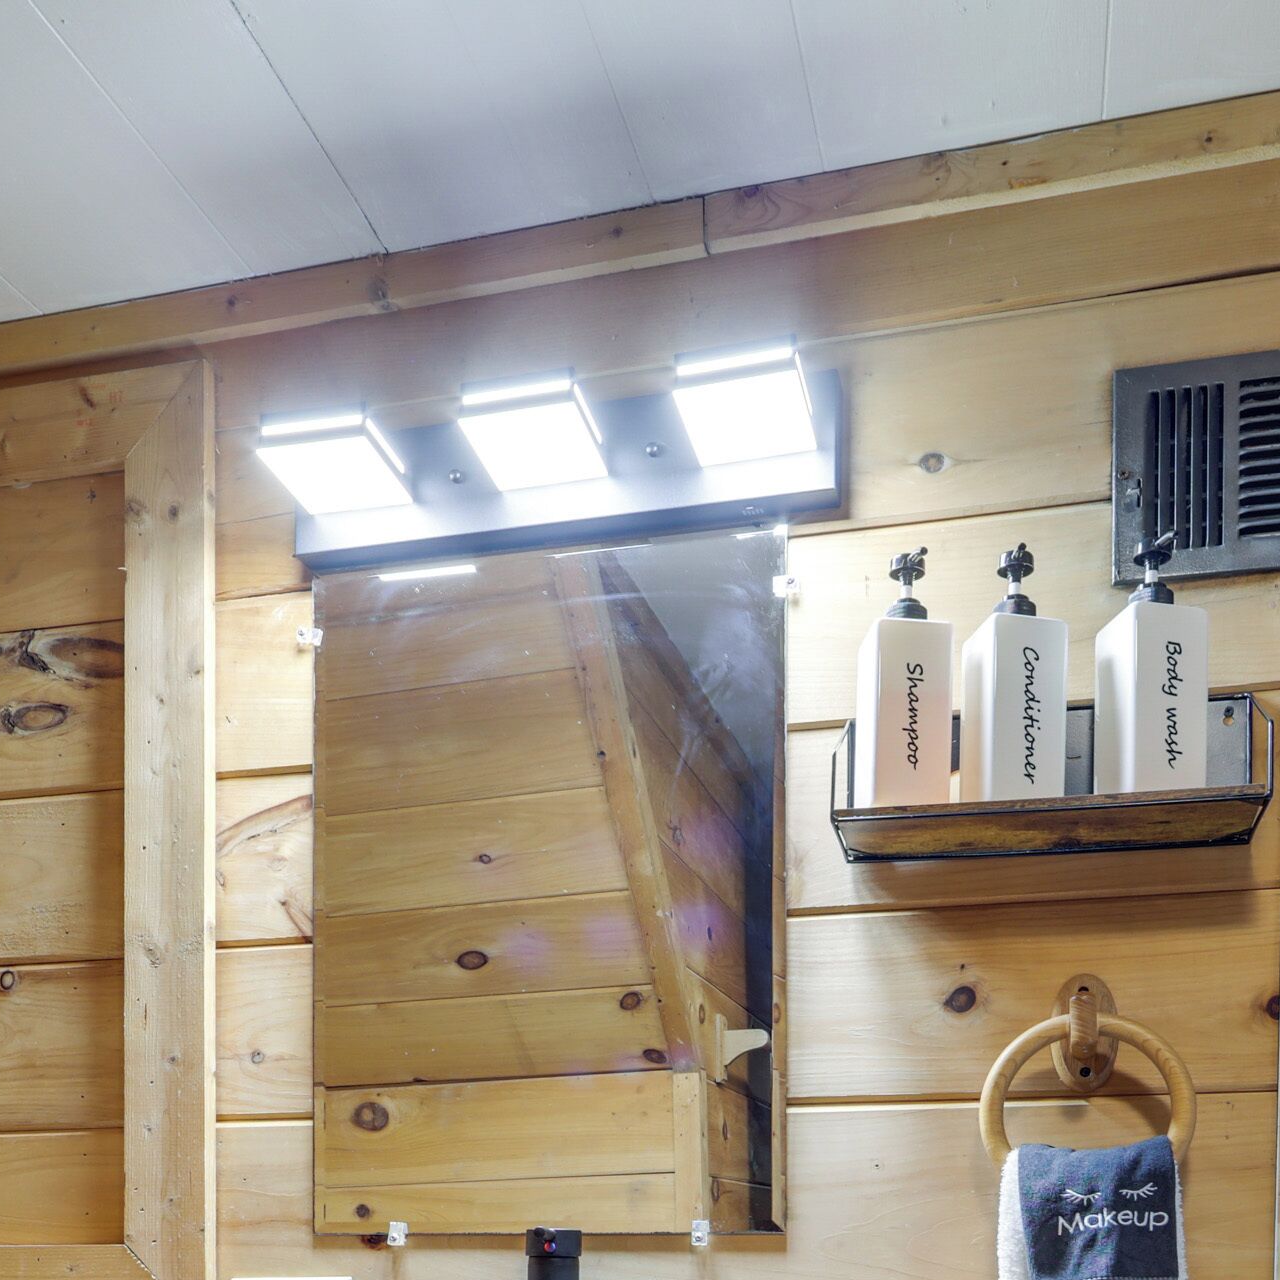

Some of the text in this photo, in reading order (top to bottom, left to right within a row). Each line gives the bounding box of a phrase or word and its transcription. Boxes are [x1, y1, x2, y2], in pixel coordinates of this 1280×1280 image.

[903, 662, 925, 771] Shampoo
[1022, 646, 1041, 785] Conditioner
[1161, 640, 1183, 770] Body wash
[1057, 1207, 1169, 1236] Makeup
